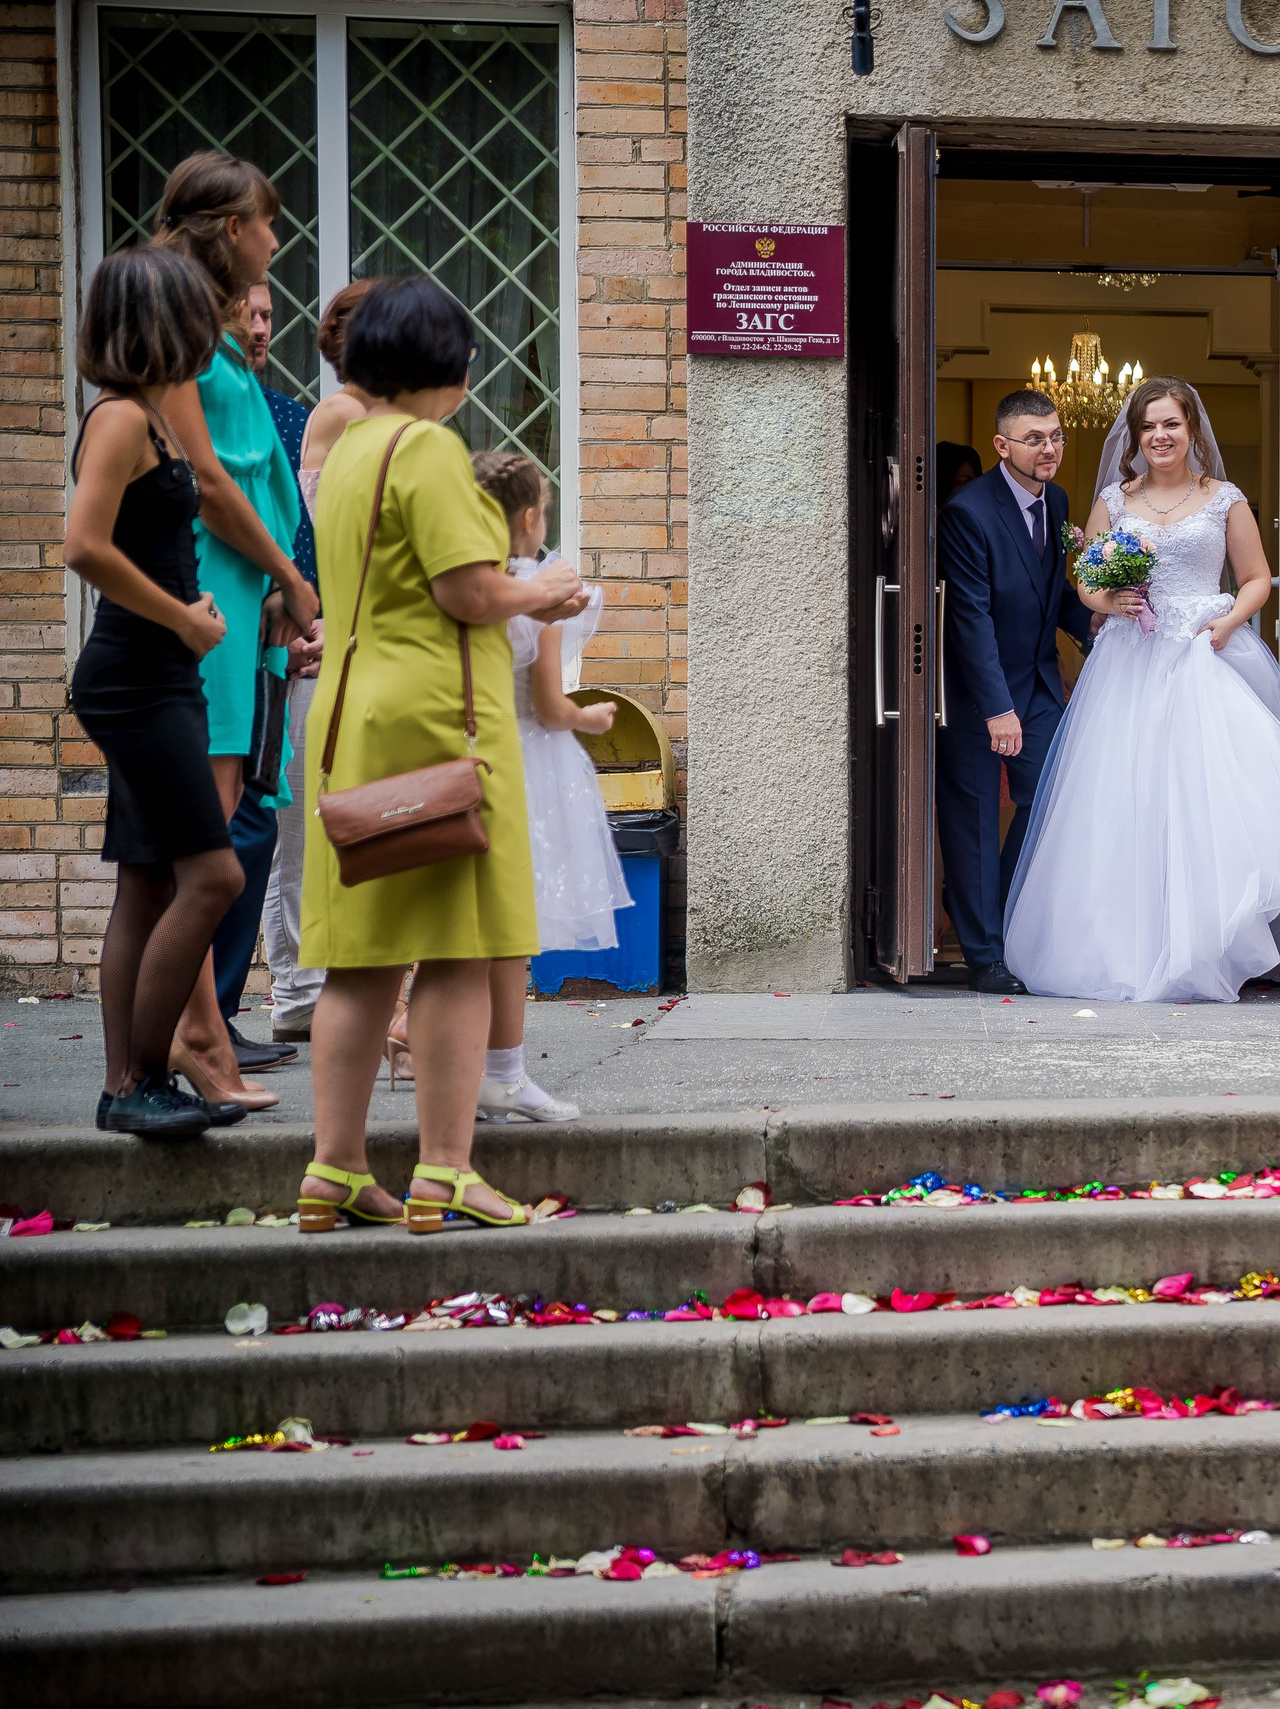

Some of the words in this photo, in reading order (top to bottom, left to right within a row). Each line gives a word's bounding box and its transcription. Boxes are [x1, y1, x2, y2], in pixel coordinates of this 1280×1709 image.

[703, 224, 769, 234] РОССИЙСКАЯ
[770, 226, 828, 235] ФЕДЕРАЦИЯ
[730, 262, 803, 270] АДМИНИСТРАЦИЯ
[723, 283, 750, 293] Отдел
[713, 293, 772, 301] гражданского
[729, 301, 782, 311] Ленинскому
[784, 302, 815, 311] району
[736, 313, 794, 330] ЗАГС
